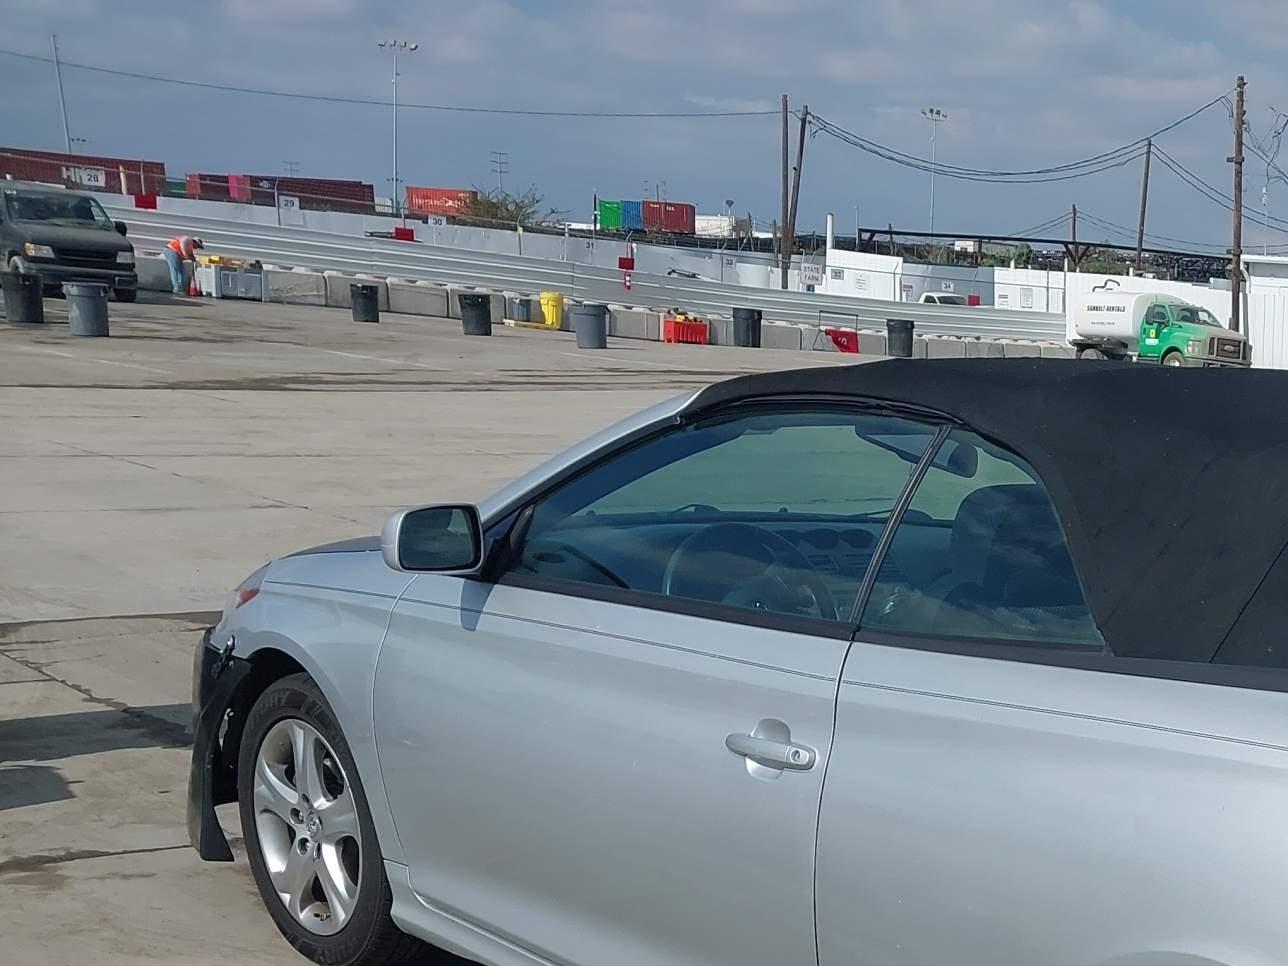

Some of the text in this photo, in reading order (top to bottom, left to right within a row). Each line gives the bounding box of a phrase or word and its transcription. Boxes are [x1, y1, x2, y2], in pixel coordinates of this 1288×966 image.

[432, 217, 443, 226] 30
[585, 241, 594, 249] 31
[803, 265, 820, 274] STATE
[803, 273, 820, 282] FARM
[1106, 305, 1126, 313] RENTALS
